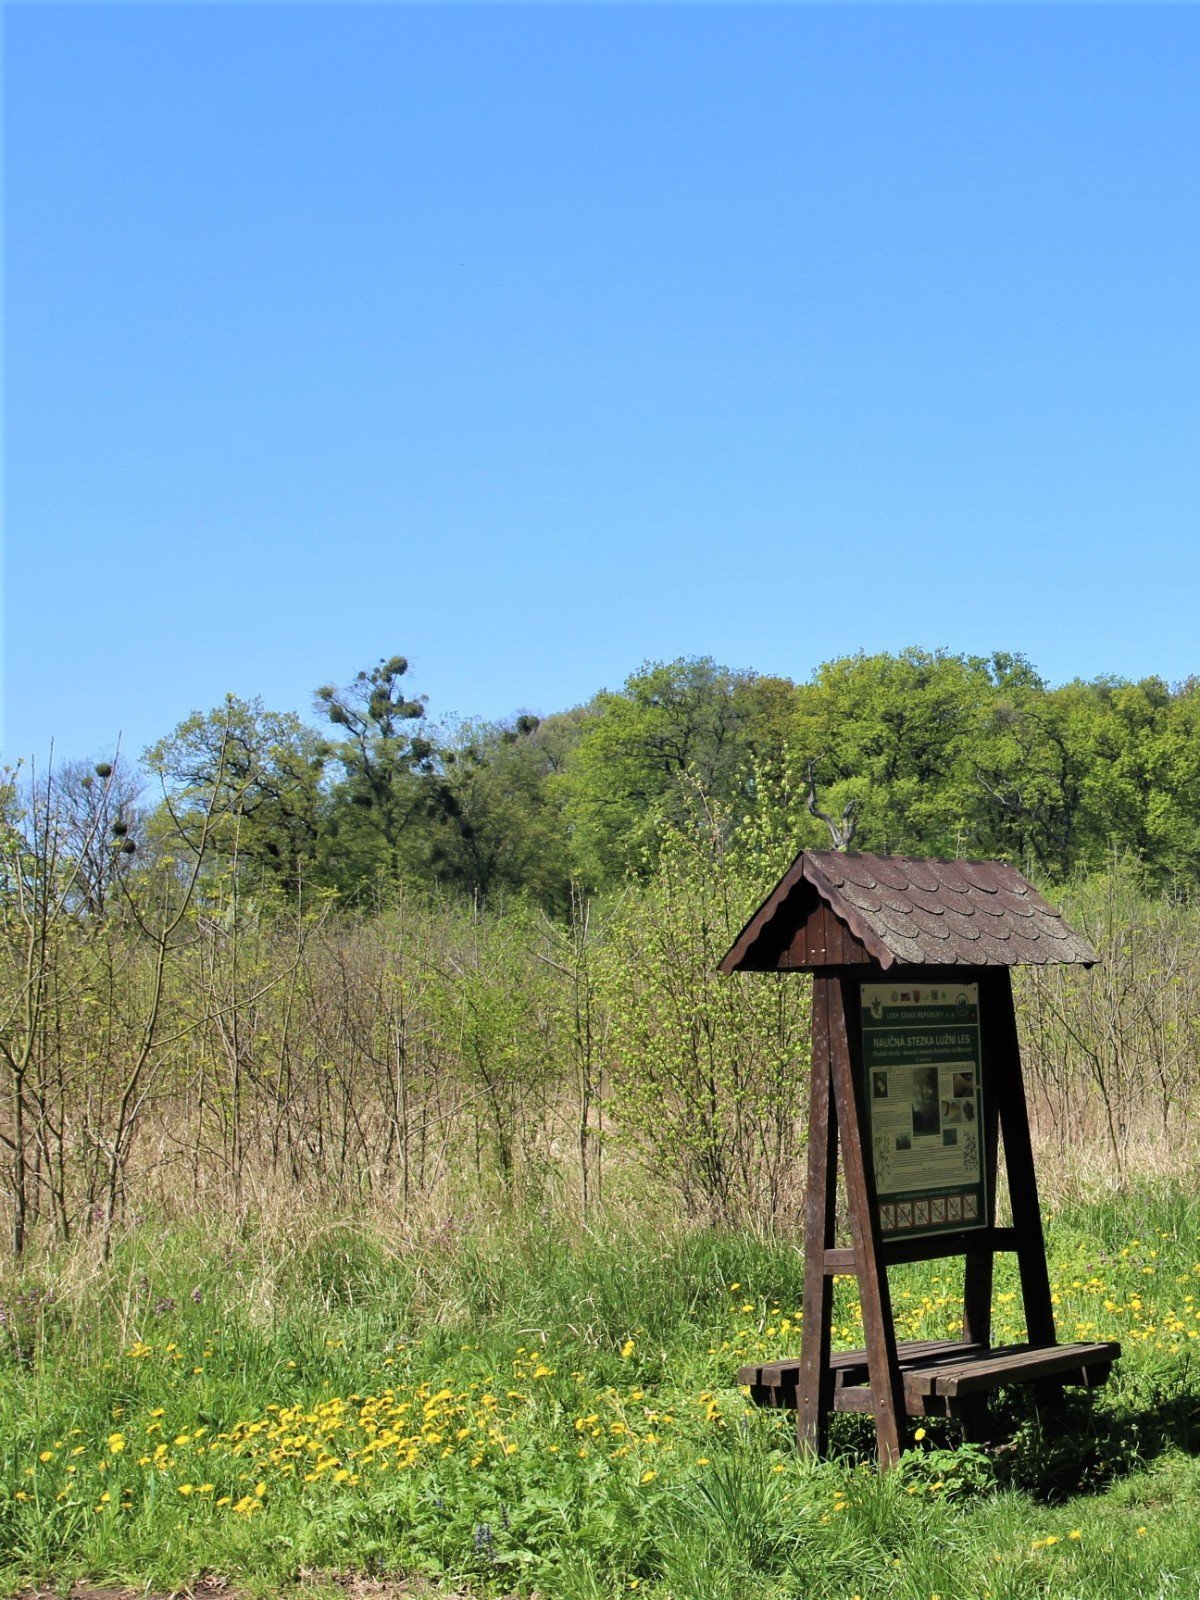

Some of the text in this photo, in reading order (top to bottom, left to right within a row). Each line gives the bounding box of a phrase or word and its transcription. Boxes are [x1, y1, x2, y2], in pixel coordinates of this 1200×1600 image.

[873, 1033, 970, 1047] NAUČNÁ STEZKA LUŽNÍ LES
